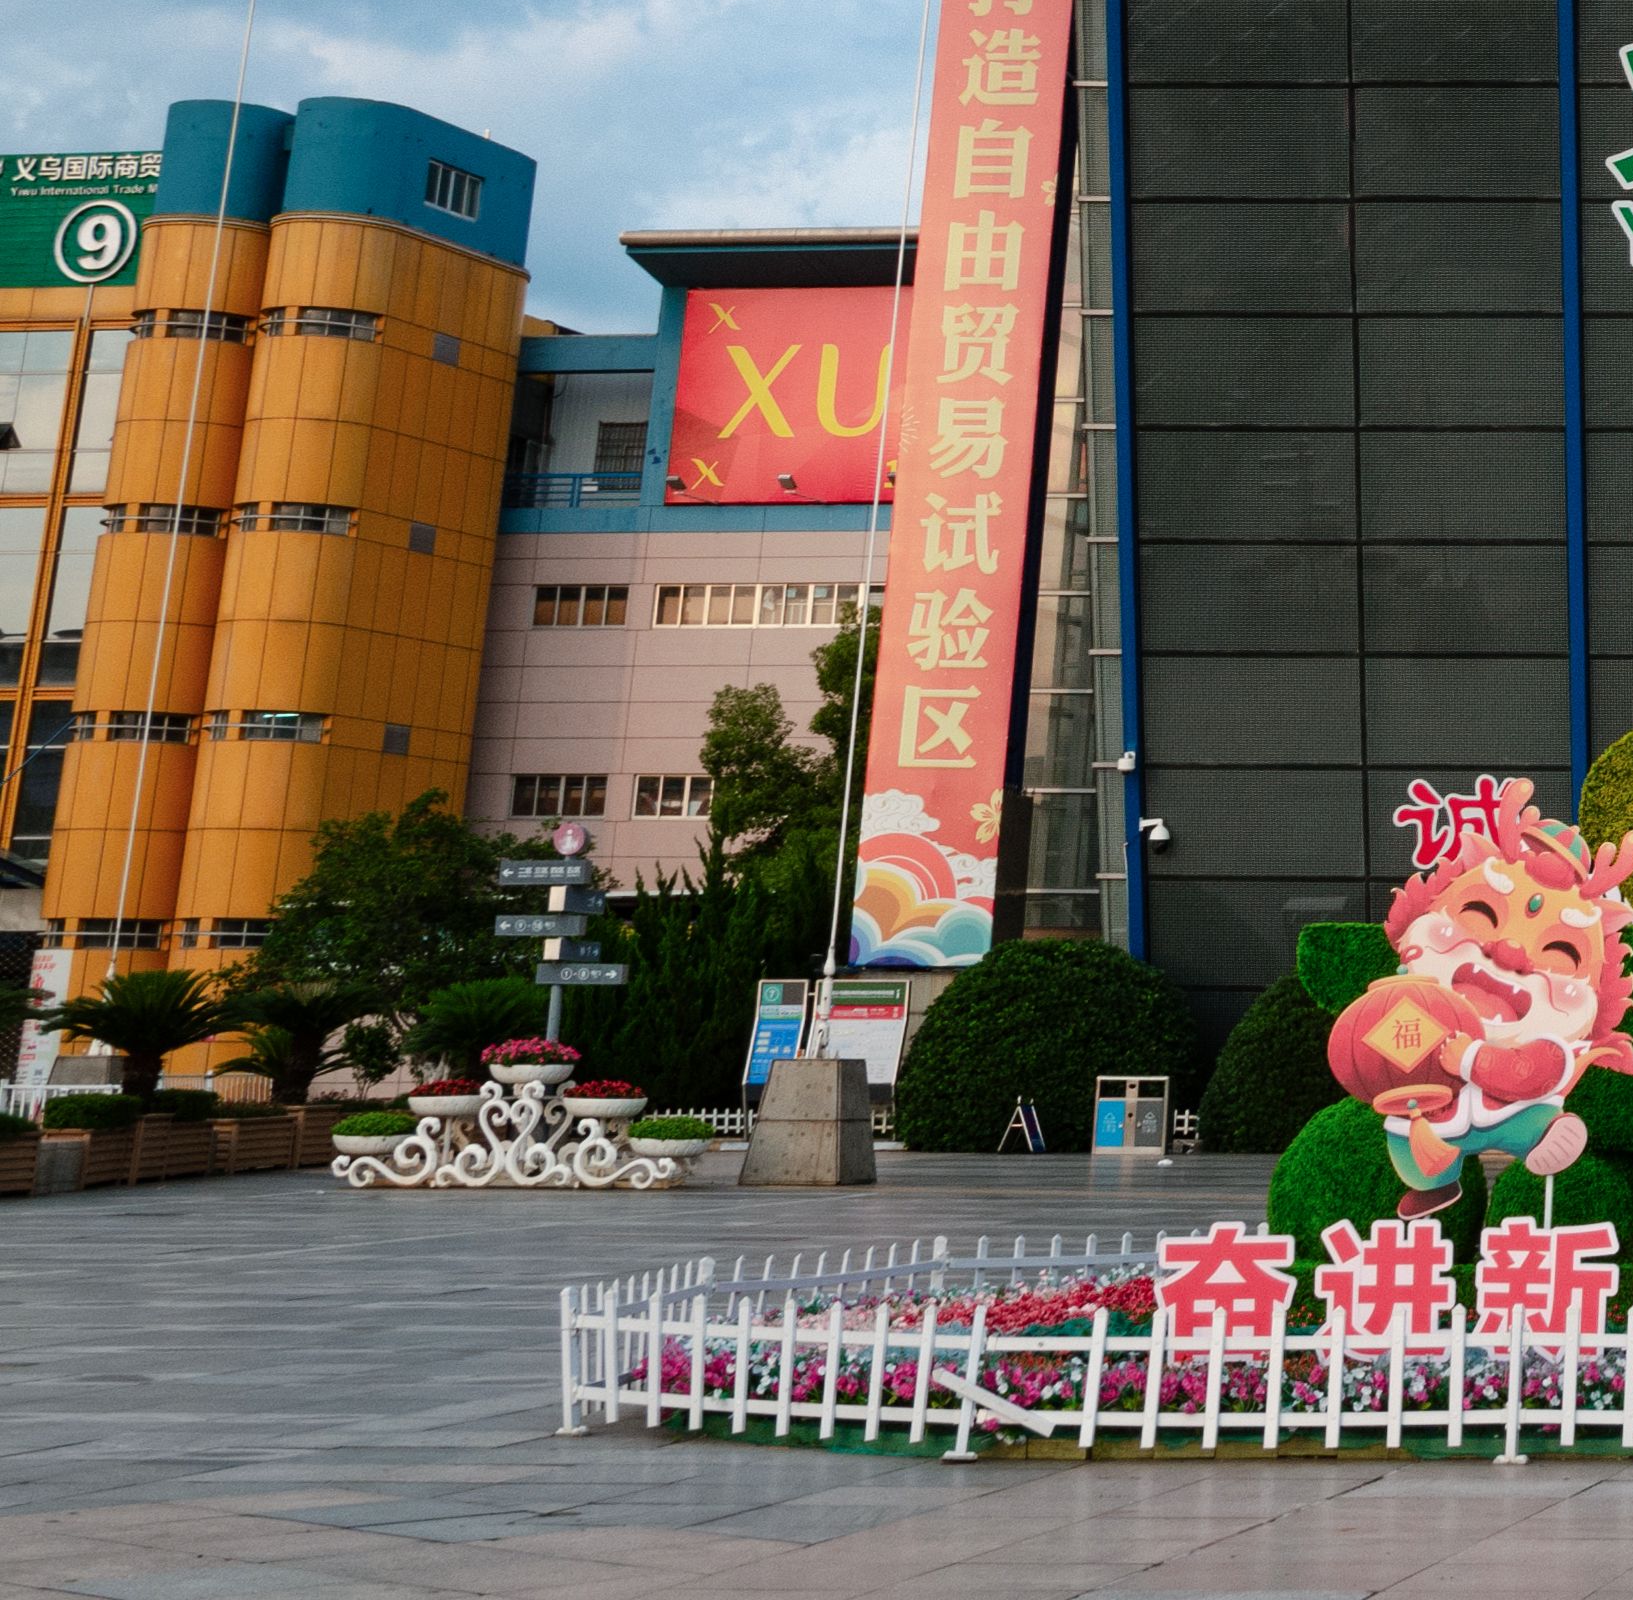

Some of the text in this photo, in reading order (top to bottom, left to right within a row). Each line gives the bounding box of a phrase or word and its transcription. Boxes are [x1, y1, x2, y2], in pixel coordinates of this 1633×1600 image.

[12, 153, 163, 181] 义乌国际商贸
[40, 185, 109, 196] International
[113, 184, 144, 194] Trade
[1392, 1018, 1422, 1050] 福
